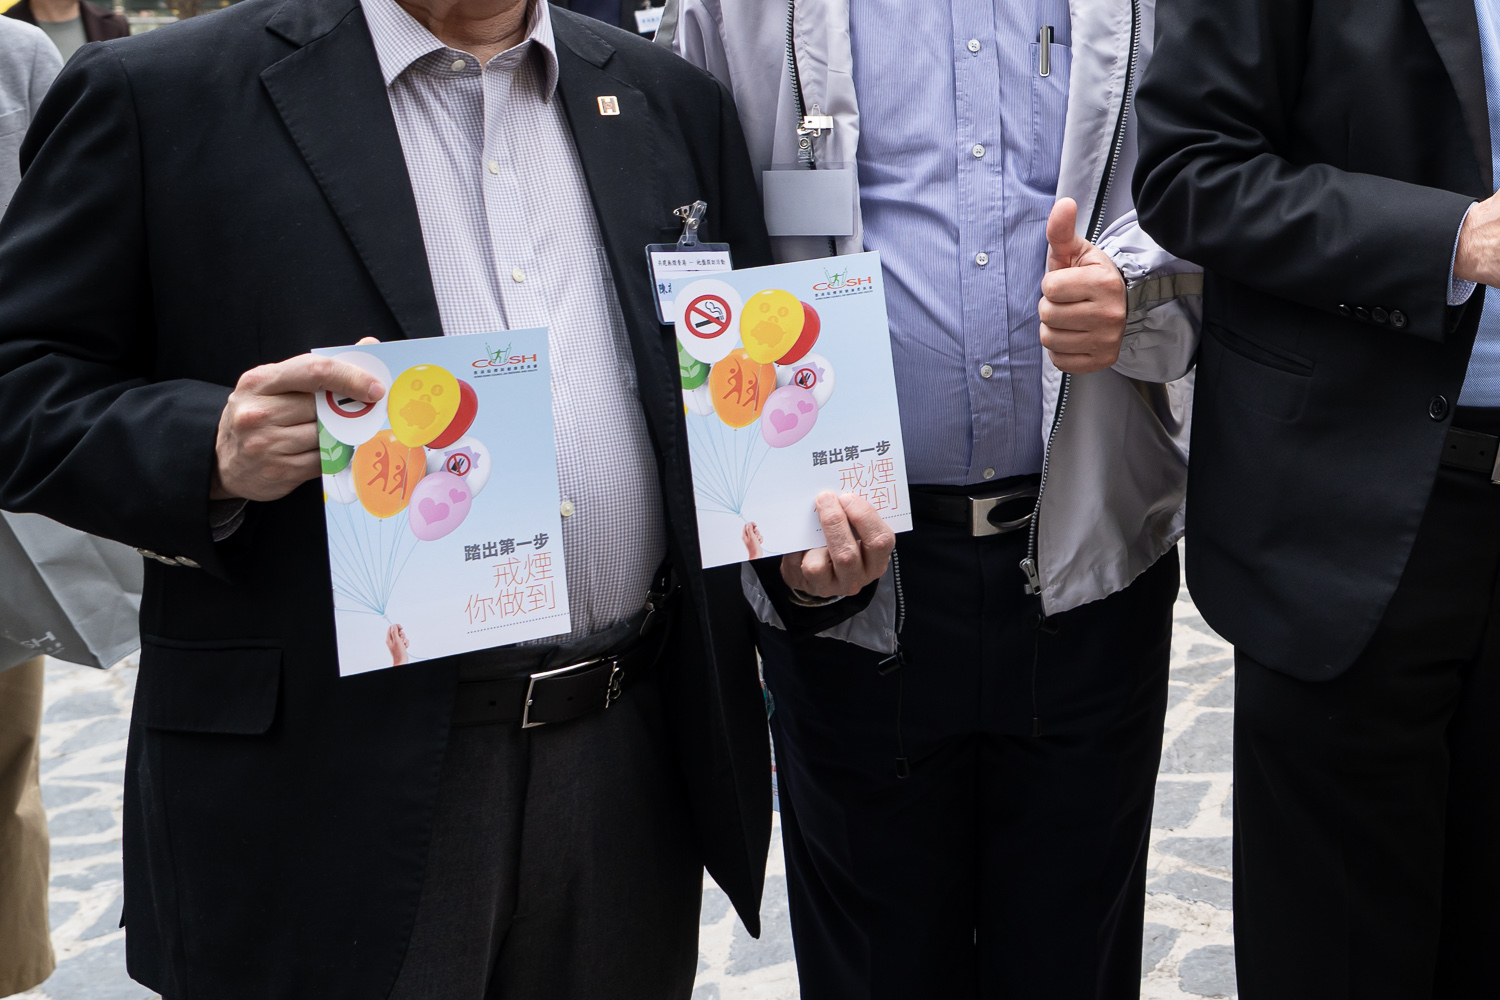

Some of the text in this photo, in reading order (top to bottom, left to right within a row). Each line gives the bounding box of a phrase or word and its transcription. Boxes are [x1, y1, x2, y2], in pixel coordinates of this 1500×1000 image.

[812, 440, 891, 467] 踏出第一步
[838, 457, 896, 491] 戒煙
[464, 532, 549, 562] 踏出第一步
[492, 551, 555, 589] 戒煙
[464, 580, 556, 625] 你做到
